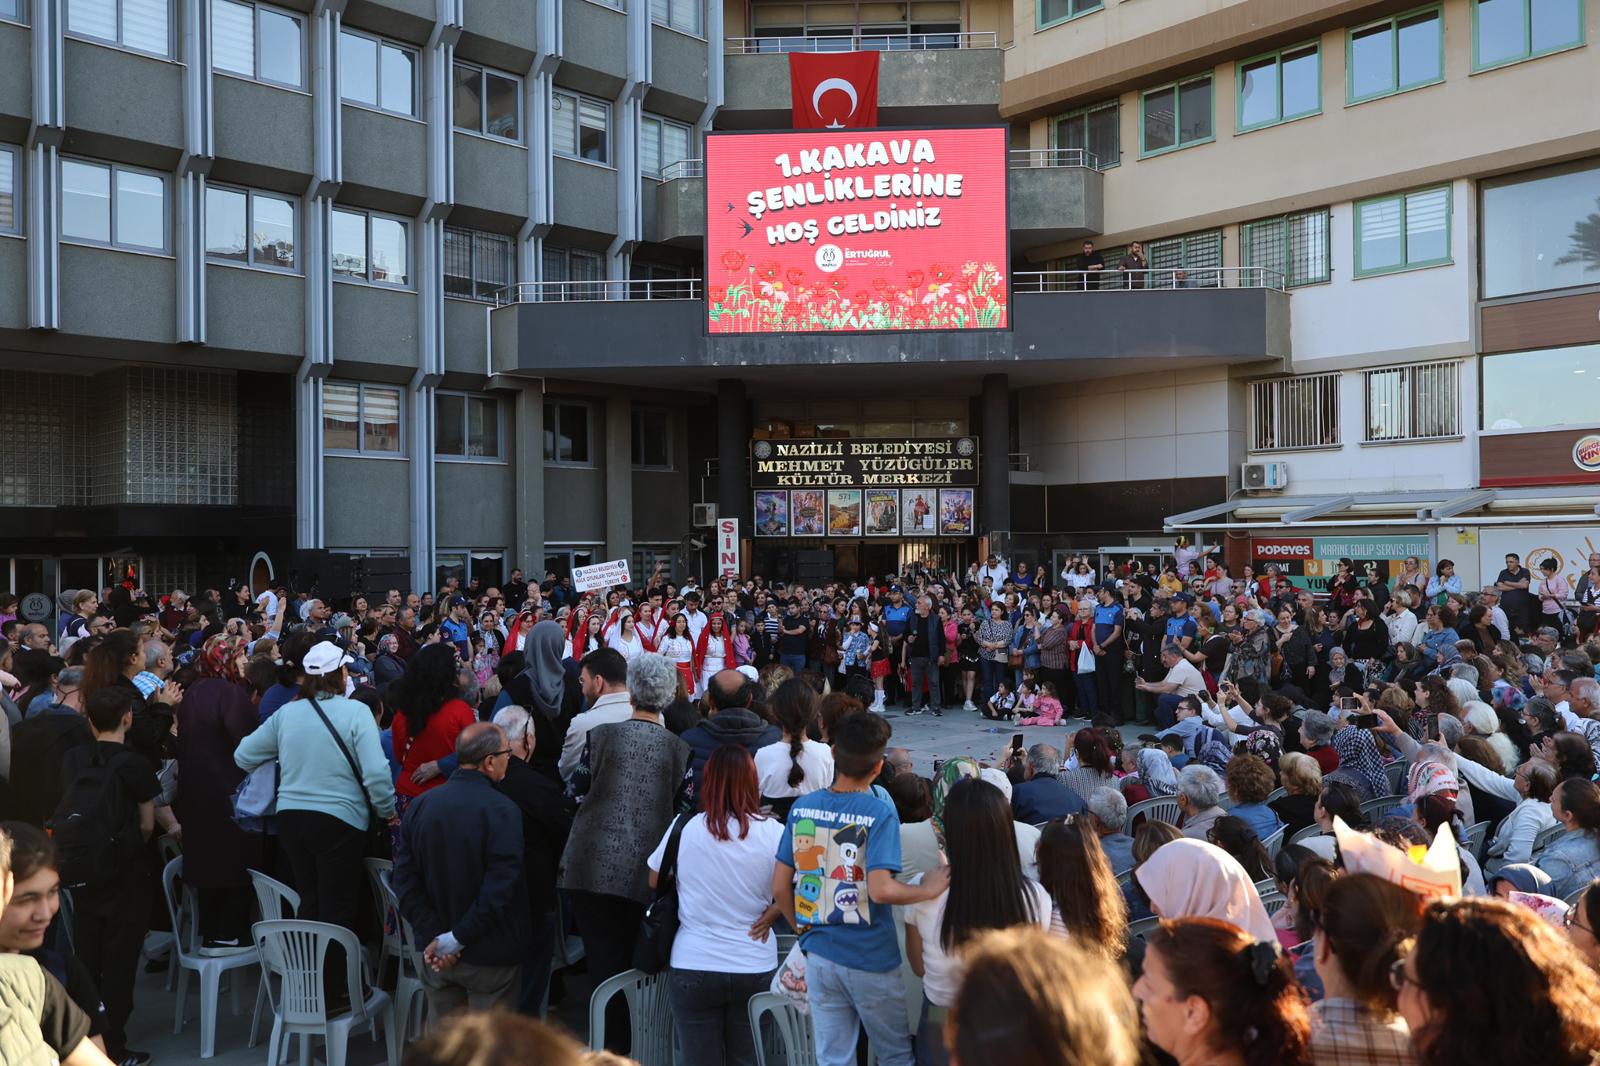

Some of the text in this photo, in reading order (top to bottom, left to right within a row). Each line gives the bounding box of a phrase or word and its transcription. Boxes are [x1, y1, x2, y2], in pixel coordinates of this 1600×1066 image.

[774, 139, 935, 178] 1.KAKAVA
[747, 167, 963, 220] ŞENLİKLERİNE
[766, 201, 941, 245] HOŞ GELDİNİZ
[845, 249, 891, 258] ERTUĞRUL
[777, 440, 952, 456] NAZİLLİ BELEDİYESİ
[757, 456, 973, 472] MEHMET YÜZÜGÜLER
[777, 471, 952, 485] KÜLTÜR MERKEZİ
